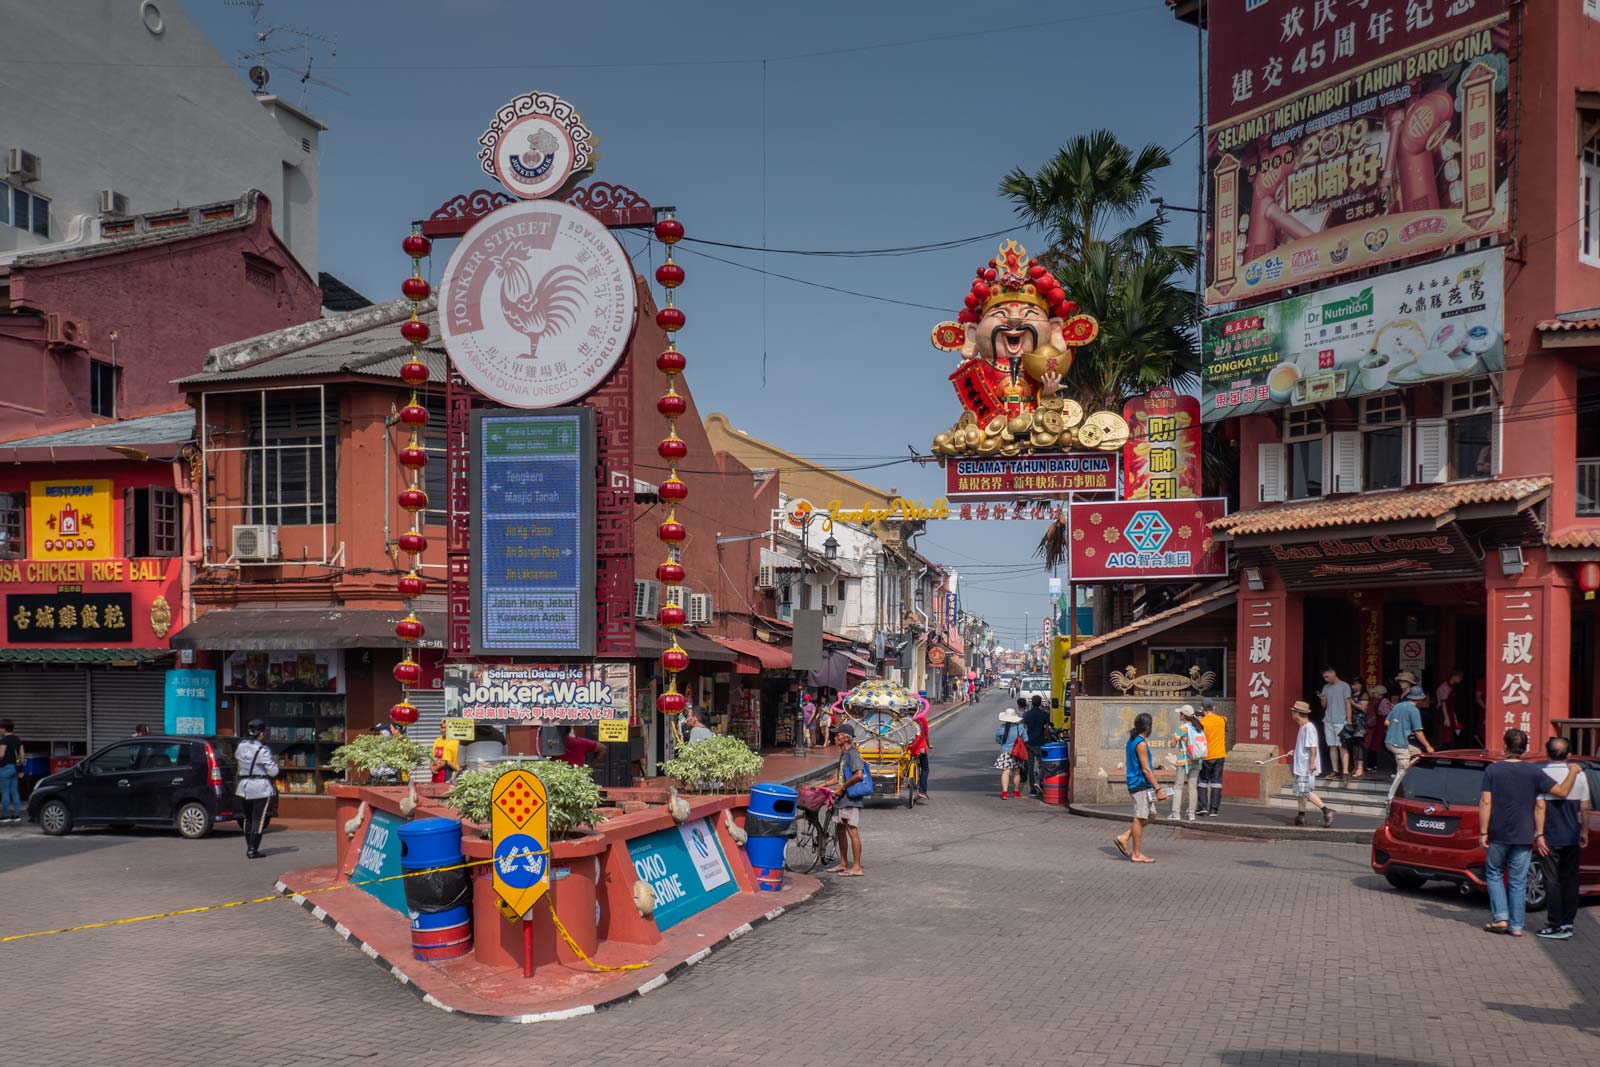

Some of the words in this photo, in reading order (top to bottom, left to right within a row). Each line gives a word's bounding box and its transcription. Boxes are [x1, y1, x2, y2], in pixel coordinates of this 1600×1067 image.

[1280, 0, 1367, 42] 欢庆
[1217, 117, 1271, 152] SELAMAT
[1274, 86, 1352, 130] MENYAMBUT
[1356, 65, 1402, 95] TAHUN
[1406, 49, 1448, 83] BARU
[1452, 31, 1492, 66] CINA
[1272, 126, 1301, 148] HAPPY
[1306, 110, 1349, 134] CHINESE
[1352, 100, 1377, 118] NEW
[1380, 85, 1411, 107] YEAR
[1470, 91, 1486, 200] 万事如意
[511, 158, 535, 177] JONKER
[536, 156, 552, 174] WALK
[1287, 145, 1382, 212] 嘟嘟好
[1219, 179, 1233, 271] 新年快乐
[568, 221, 615, 266] HERITAGE
[455, 246, 486, 328] JONKER
[484, 221, 551, 253] STREET
[611, 266, 625, 333] CULTURAL
[1308, 312, 1319, 323] Dr
[1324, 303, 1368, 320] Nutrition
[461, 338, 497, 382] WARISAN
[496, 378, 529, 396] DUNIA
[533, 377, 579, 396] UNESCO
[583, 337, 617, 377] WORLD
[1207, 356, 1258, 375] TONGKAT
[1261, 352, 1279, 365] ALI
[958, 461, 1006, 475] SELAMAT
[1010, 460, 1047, 473] TAHUN
[1050, 459, 1079, 472] BARU
[1081, 459, 1108, 471] CINA
[1149, 417, 1177, 499] 财神到
[45, 486, 94, 497] RESTORAN
[505, 489, 532, 505] Masjid
[533, 490, 559, 502] Tanah
[822, 499, 891, 532] Jonker
[892, 497, 949, 521] Walk
[1270, 543, 1323, 561] San
[1318, 536, 1376, 557] Shu
[1371, 533, 1455, 554] Gong
[27, 563, 85, 582] CHICKEN
[92, 562, 123, 581] RICE
[129, 561, 167, 581] BALL
[492, 598, 517, 608] Jalan
[519, 598, 544, 610] Hang
[547, 598, 572, 608] Jebat
[498, 612, 541, 622] Kawasan
[543, 612, 566, 622] Antik
[1248, 602, 1273, 699] 三叔公
[1500, 591, 1534, 705] 三叔公
[488, 669, 528, 679] Selamat
[531, 669, 566, 681] Datang
[569, 668, 583, 679] Ke
[1143, 679, 1182, 687] Malacca
[463, 681, 543, 704] Jonker
[551, 680, 612, 704] Walk
[366, 823, 389, 849] TOKIO
[359, 845, 387, 875] MARINE
[634, 853, 667, 882] OKIO
[652, 873, 687, 909] ARINE
